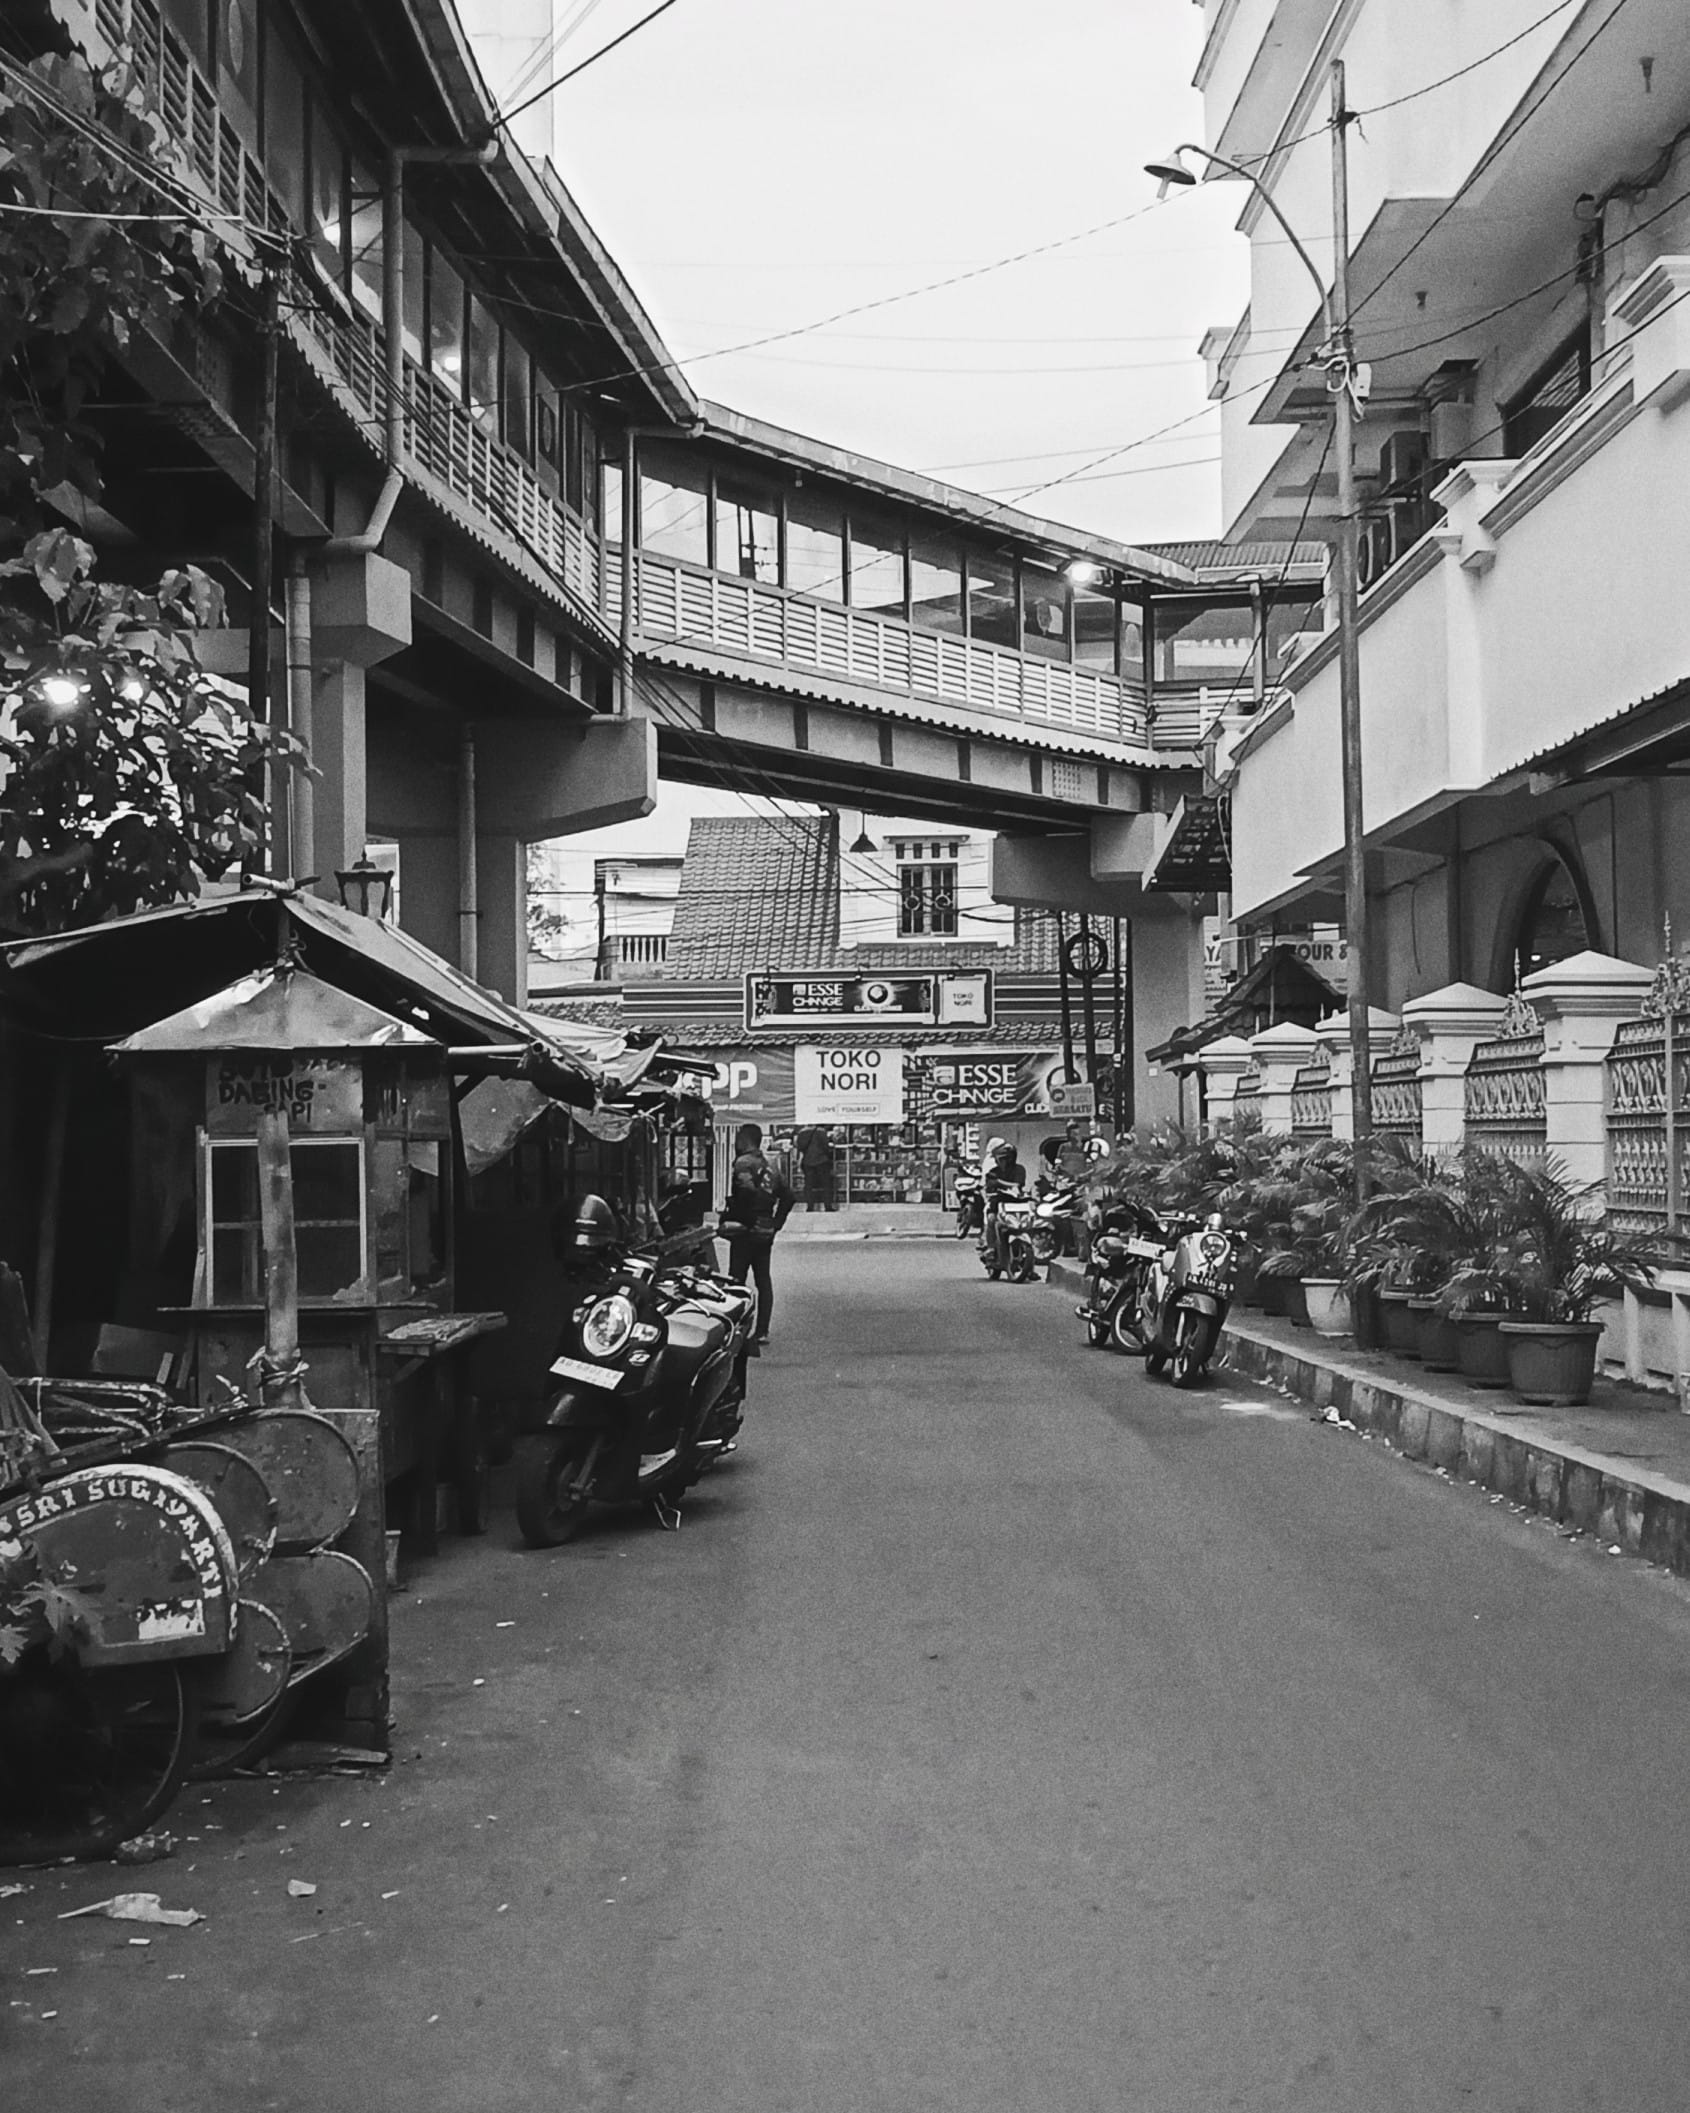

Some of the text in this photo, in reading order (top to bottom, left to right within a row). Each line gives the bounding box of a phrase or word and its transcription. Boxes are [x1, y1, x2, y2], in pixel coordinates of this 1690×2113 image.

[808, 983, 844, 996] ESSE
[792, 996, 844, 1006] CHANGE
[815, 1050, 881, 1069] TOKO
[820, 1073, 877, 1091] NORI
[958, 1064, 1018, 1086] ESSE
[932, 1088, 1017, 1104] CHANGE
[16, 1487, 77, 1528] SRI
